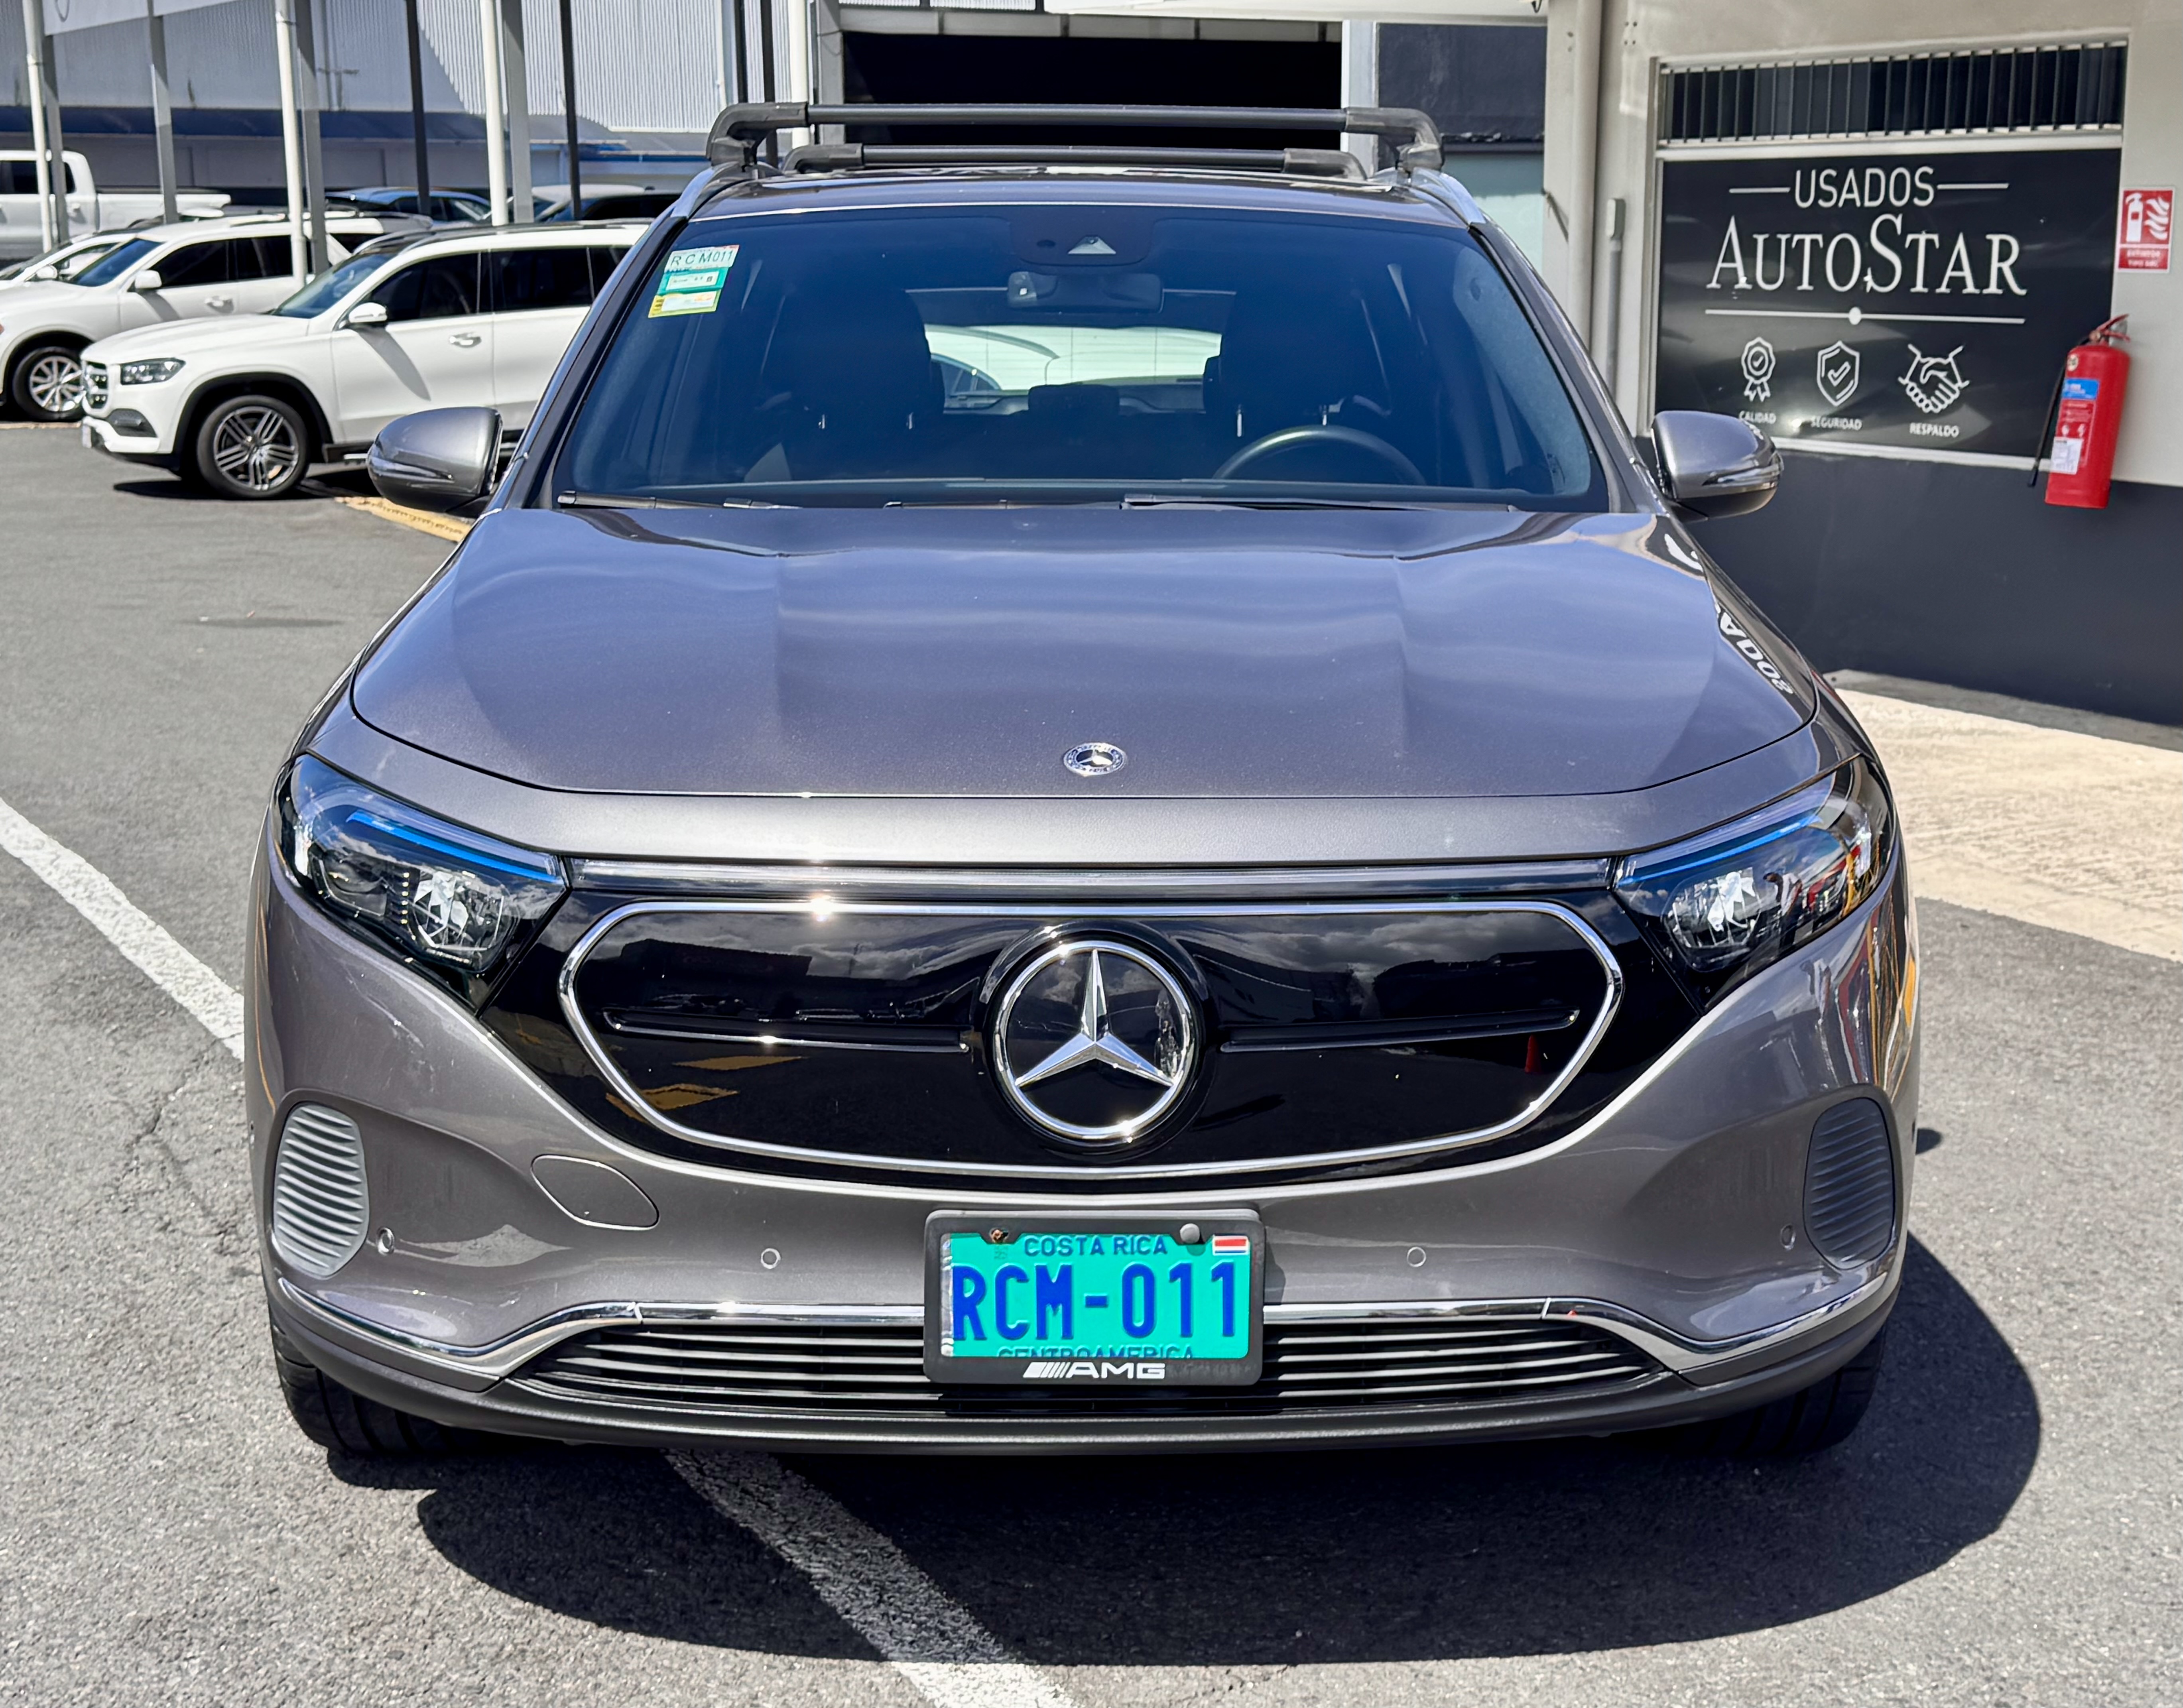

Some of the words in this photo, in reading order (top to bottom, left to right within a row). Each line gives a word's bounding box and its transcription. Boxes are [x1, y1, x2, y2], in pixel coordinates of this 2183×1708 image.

[1795, 167, 1935, 208] USADOS
[1739, 410, 1776, 424] CALIDAD
[1811, 415, 1862, 430] SEGURIDAD
[1909, 423, 1959, 437] RESPALDO
[1024, 1236, 1105, 1256] COSTA
[1114, 1236, 1168, 1255] RICA
[952, 1261, 1236, 1340] RCM-011
[1065, 1362, 1166, 1379] AMG
